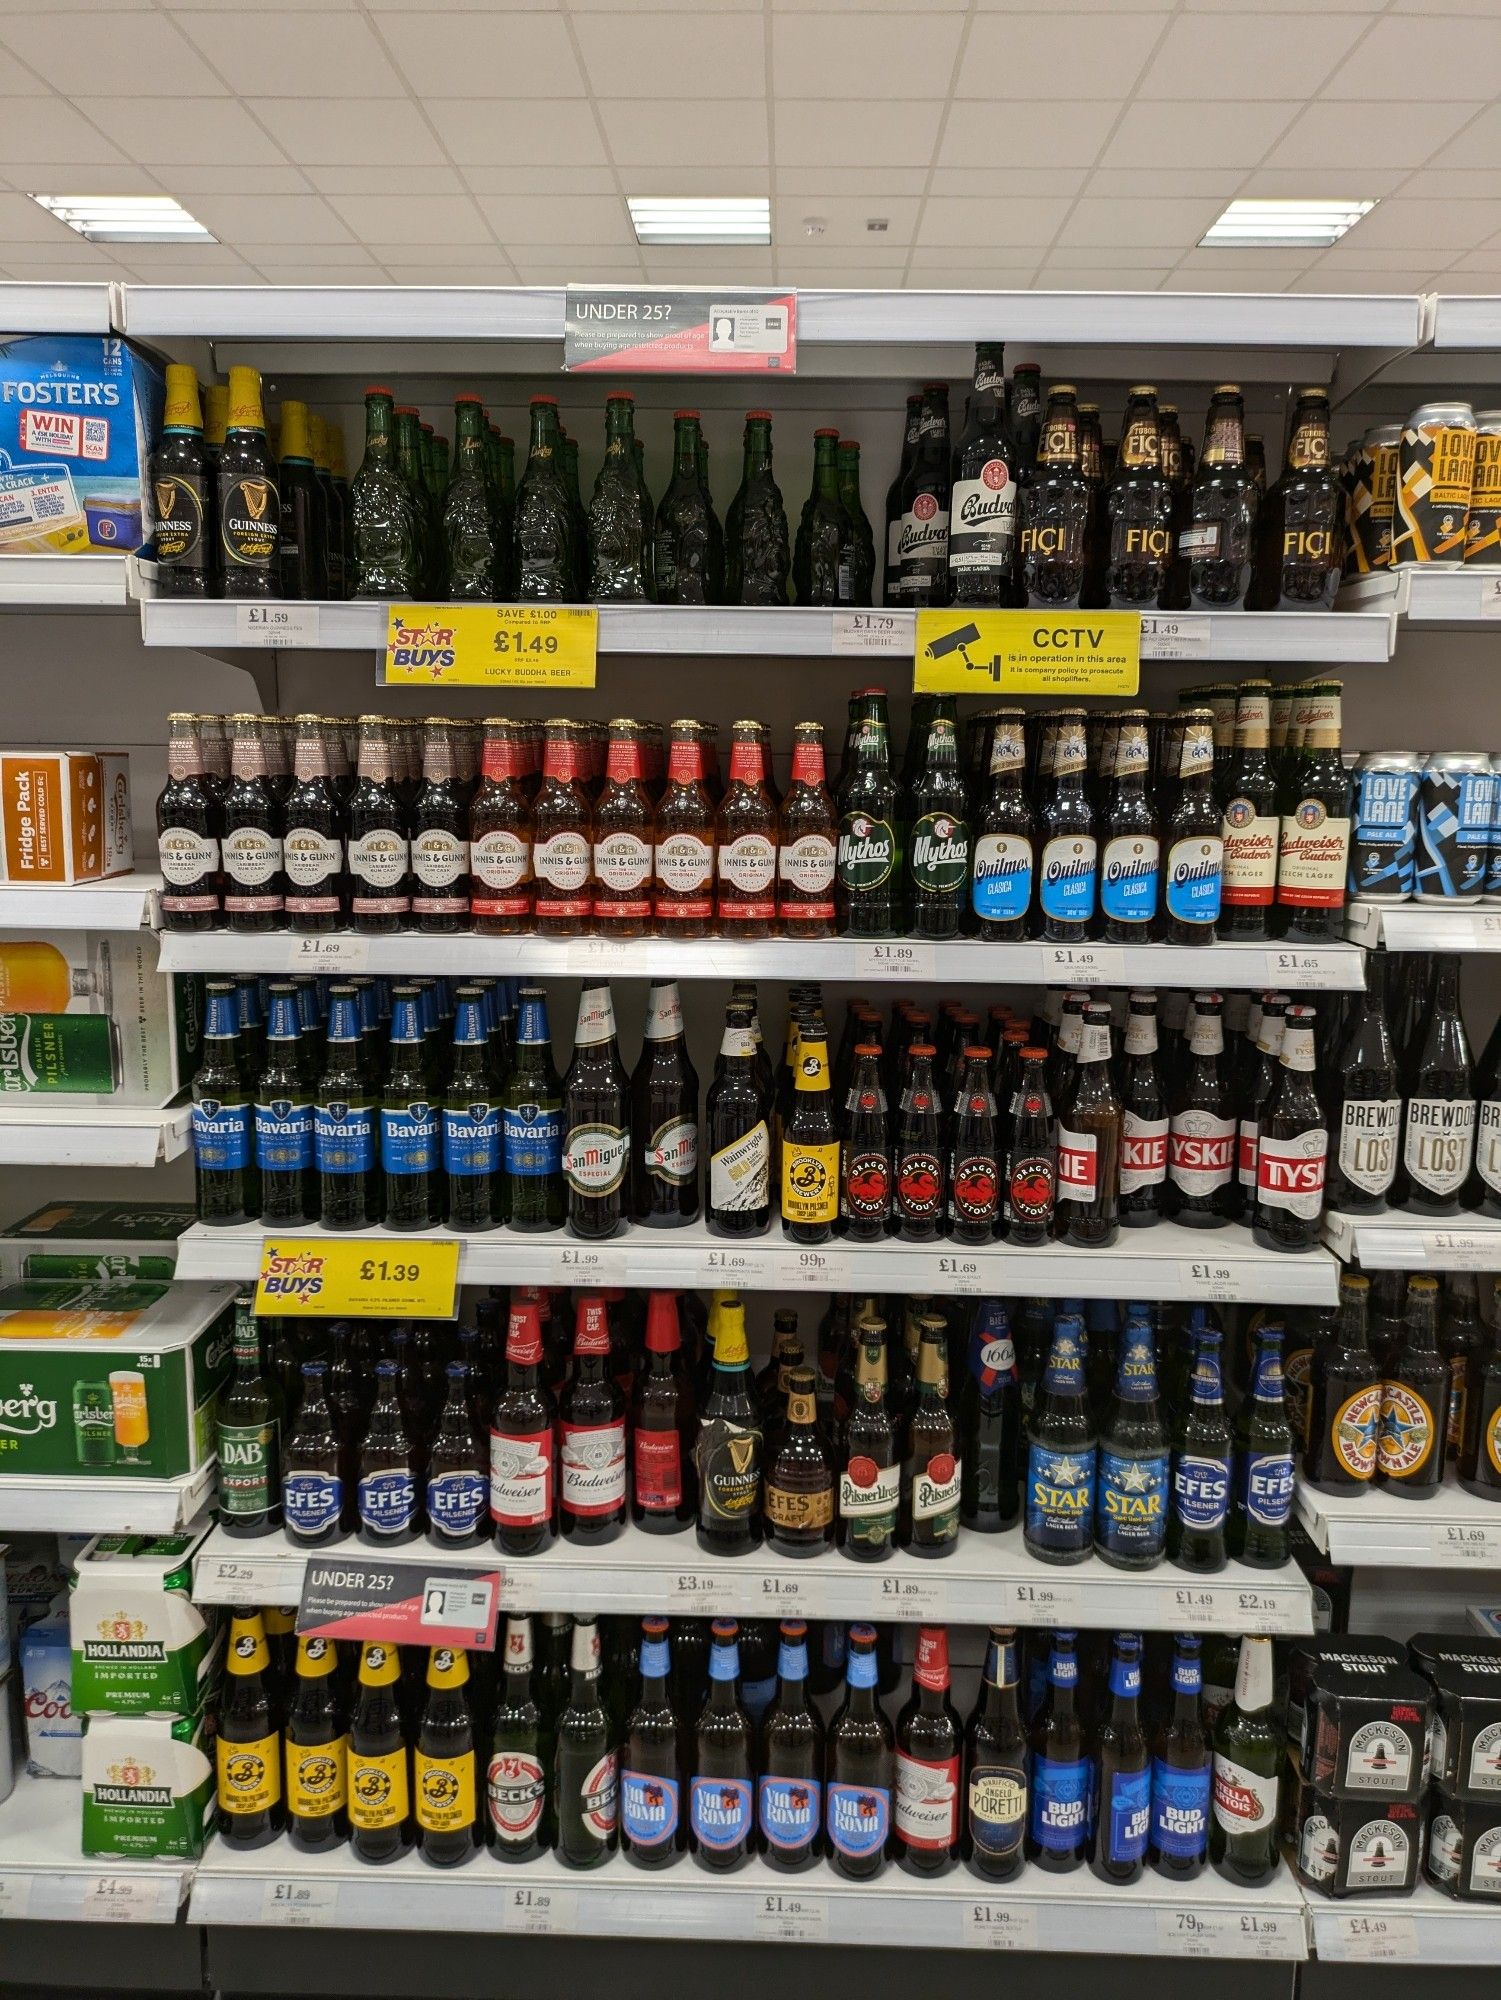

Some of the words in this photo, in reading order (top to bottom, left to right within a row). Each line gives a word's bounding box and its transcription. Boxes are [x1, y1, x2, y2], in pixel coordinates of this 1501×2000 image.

[576, 303, 638, 320] UNDER
[642, 304, 672, 321] 25?
[575, 331, 595, 339] Please
[102, 338, 122, 357] 12
[2, 382, 120, 406] FOSTER'S
[32, 414, 74, 434] WIN
[6, 476, 35, 490] CRACK
[37, 485, 60, 495] ENTER
[229, 518, 278, 535] GUINNESS
[248, 607, 289, 624] £1.59
[497, 609, 525, 619] SAVE
[530, 609, 557, 619] £1.00
[852, 615, 894, 630] £1.79
[493, 630, 558, 654] £1.49
[1032, 628, 1104, 649] CCTV
[393, 649, 456, 667] BUYS
[1008, 654, 1016, 662] is
[1018, 654, 1028, 662] in
[1030, 654, 1073, 665] operation
[1076, 655, 1085, 663] in
[1087, 655, 1104, 663] this
[485, 668, 511, 676] LUCKY
[515, 669, 547, 677] BUDDHA
[551, 669, 571, 677] BEER
[1058, 667, 1078, 675] policy
[15, 771, 31, 812] Pack
[37, 787, 46, 807] COLD
[1365, 778, 1408, 800] LOVE
[1363, 801, 1405, 823] LANE
[38, 808, 47, 834] SERVED
[18, 816, 35, 869] Fridge
[255, 851, 279, 861] GUNN
[505, 855, 527, 864] GUNN
[838, 835, 890, 872] Mythos
[913, 836, 968, 872] Mythos
[679, 858, 687, 868] &
[688, 858, 709, 867] GUNN
[300, 939, 340, 955] £1.69
[873, 946, 913, 960] £1.89
[136, 946, 144, 970] WORLD
[1054, 950, 1094, 964] £1.49
[1278, 954, 1319, 969] £1.65
[208, 998, 217, 1034] Bavaria
[275, 1000, 283, 1035] Bavaria
[42, 1023, 58, 1084] PILSNER
[255, 1117, 313, 1135] Bavaria
[314, 1119, 371, 1137] Bavaria
[504, 1120, 560, 1139] Bavaria
[719, 1132, 764, 1168] Wainwright
[1418, 1137, 1467, 1171] LOST
[792, 1158, 823, 1170] BROOKLYN
[852, 1161, 887, 1176] DRAGON
[903, 1160, 938, 1177] DRAGON
[578, 1170, 611, 1178] ESPECIAL
[960, 1165, 996, 1181] DRAGON
[855, 1199, 884, 1211] STOUT
[905, 1198, 935, 1211] STOUT
[962, 1202, 992, 1215] STOUT
[561, 1250, 599, 1264] £1.99
[707, 1251, 746, 1267] £1.69
[799, 1253, 826, 1268] 99p
[359, 1259, 420, 1281] £1.39
[938, 1258, 977, 1274] £1.69
[1190, 1264, 1230, 1280] £1.99
[264, 1277, 323, 1294] BUYS
[586, 1315, 600, 1323] OFF
[586, 1323, 601, 1331] CAP.
[1050, 1355, 1081, 1370] STAR
[222, 1441, 263, 1465] DAB
[1402, 1443, 1422, 1466] ALE
[223, 1478, 268, 1488] EXPORT
[1174, 1472, 1226, 1499] EFES
[285, 1488, 335, 1508] EFES
[364, 1484, 415, 1509] EFES
[433, 1486, 484, 1509] EFES
[1034, 1482, 1090, 1508] STAR
[1104, 1490, 1162, 1515] STAR
[291, 1507, 327, 1517] PILSENER
[1045, 1521, 1063, 1529] LAGER
[1446, 1527, 1486, 1543] £1.69
[216, 1564, 253, 1580] £2.29
[311, 1570, 365, 1588] UNDER
[368, 1574, 395, 1591] 25?
[677, 1575, 714, 1591] £3.19
[761, 1578, 799, 1594] £1.69
[881, 1578, 919, 1595] £1.89
[1016, 1586, 1054, 1602] £1.99
[1238, 1594, 1277, 1610] £2.19
[87, 1644, 162, 1659] HOLLANDIA
[1320, 1652, 1399, 1665] MACKESON
[94, 1672, 158, 1680] IMPORTED
[1341, 1662, 1387, 1674] STOUT
[105, 1691, 151, 1699] PREMIUM
[1353, 1724, 1408, 1753] MACKESON
[1358, 1775, 1396, 1786] STOUT
[96, 1787, 171, 1804] HOLLANDIA
[985, 1787, 1012, 1797] ANGELO
[974, 1792, 1022, 1815] PORETTI
[1048, 1800, 1083, 1815] BUD
[103, 1815, 166, 1824] IMPORTED
[1041, 1810, 1086, 1828] LIGHT
[1165, 1806, 1202, 1820] BUD
[1159, 1815, 1206, 1834] LIGHT
[1355, 1827, 1405, 1850] MACKESON
[1358, 1872, 1395, 1882] STOUT
[273, 1884, 310, 1900] £1.89
[514, 1891, 551, 1907] £1.89
[765, 1896, 802, 1913] £1.49
[973, 1906, 1010, 1923] £1.99
[1175, 1913, 1204, 1931] 79p
[1239, 1916, 1277, 1933] £1.99
[1350, 1918, 1387, 1934] £4.49
